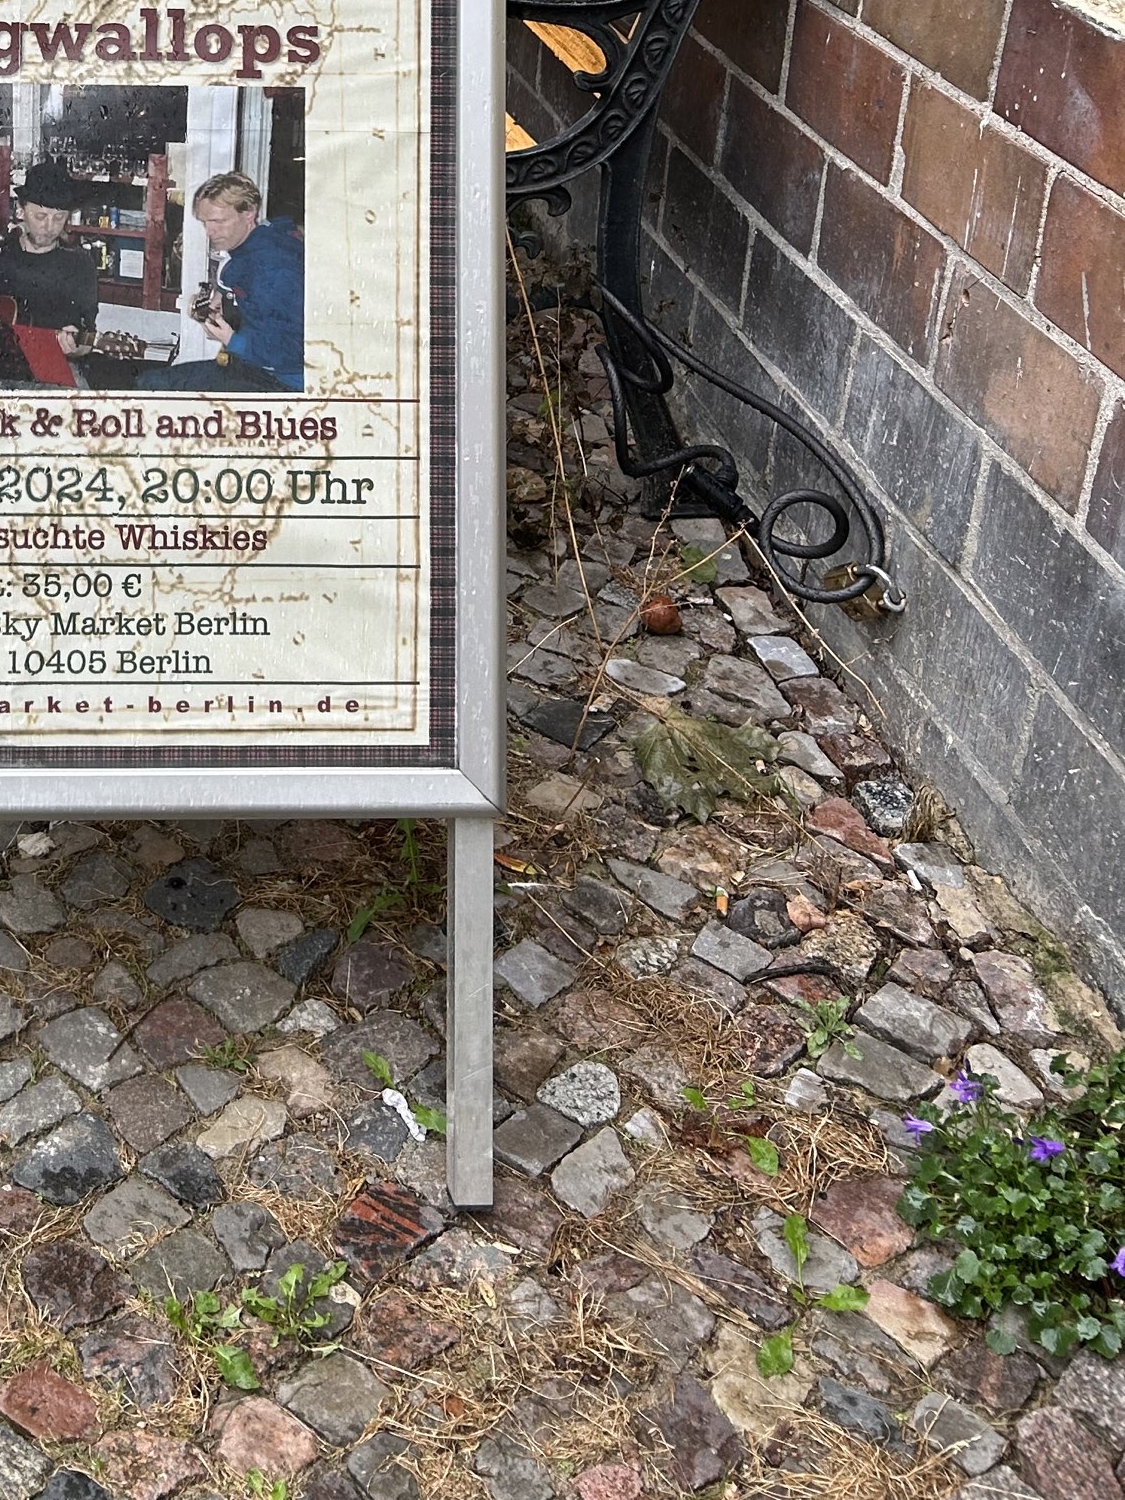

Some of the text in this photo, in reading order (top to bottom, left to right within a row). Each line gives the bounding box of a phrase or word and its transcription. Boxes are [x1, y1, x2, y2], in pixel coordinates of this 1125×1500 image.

[29, 407, 63, 438] &
[75, 409, 146, 438] Roll
[156, 410, 226, 439] and
[235, 410, 338, 441] Blues
[141, 467, 275, 504] 20:00
[287, 470, 374, 505] Uhr
[114, 524, 268, 551] Whiskies
[22, 572, 113, 603] 35,00
[121, 573, 143, 598] €
[50, 612, 166, 636] Market
[174, 612, 271, 636] Berlin
[7, 650, 107, 676] 10405
[116, 650, 213, 675] Berlin
